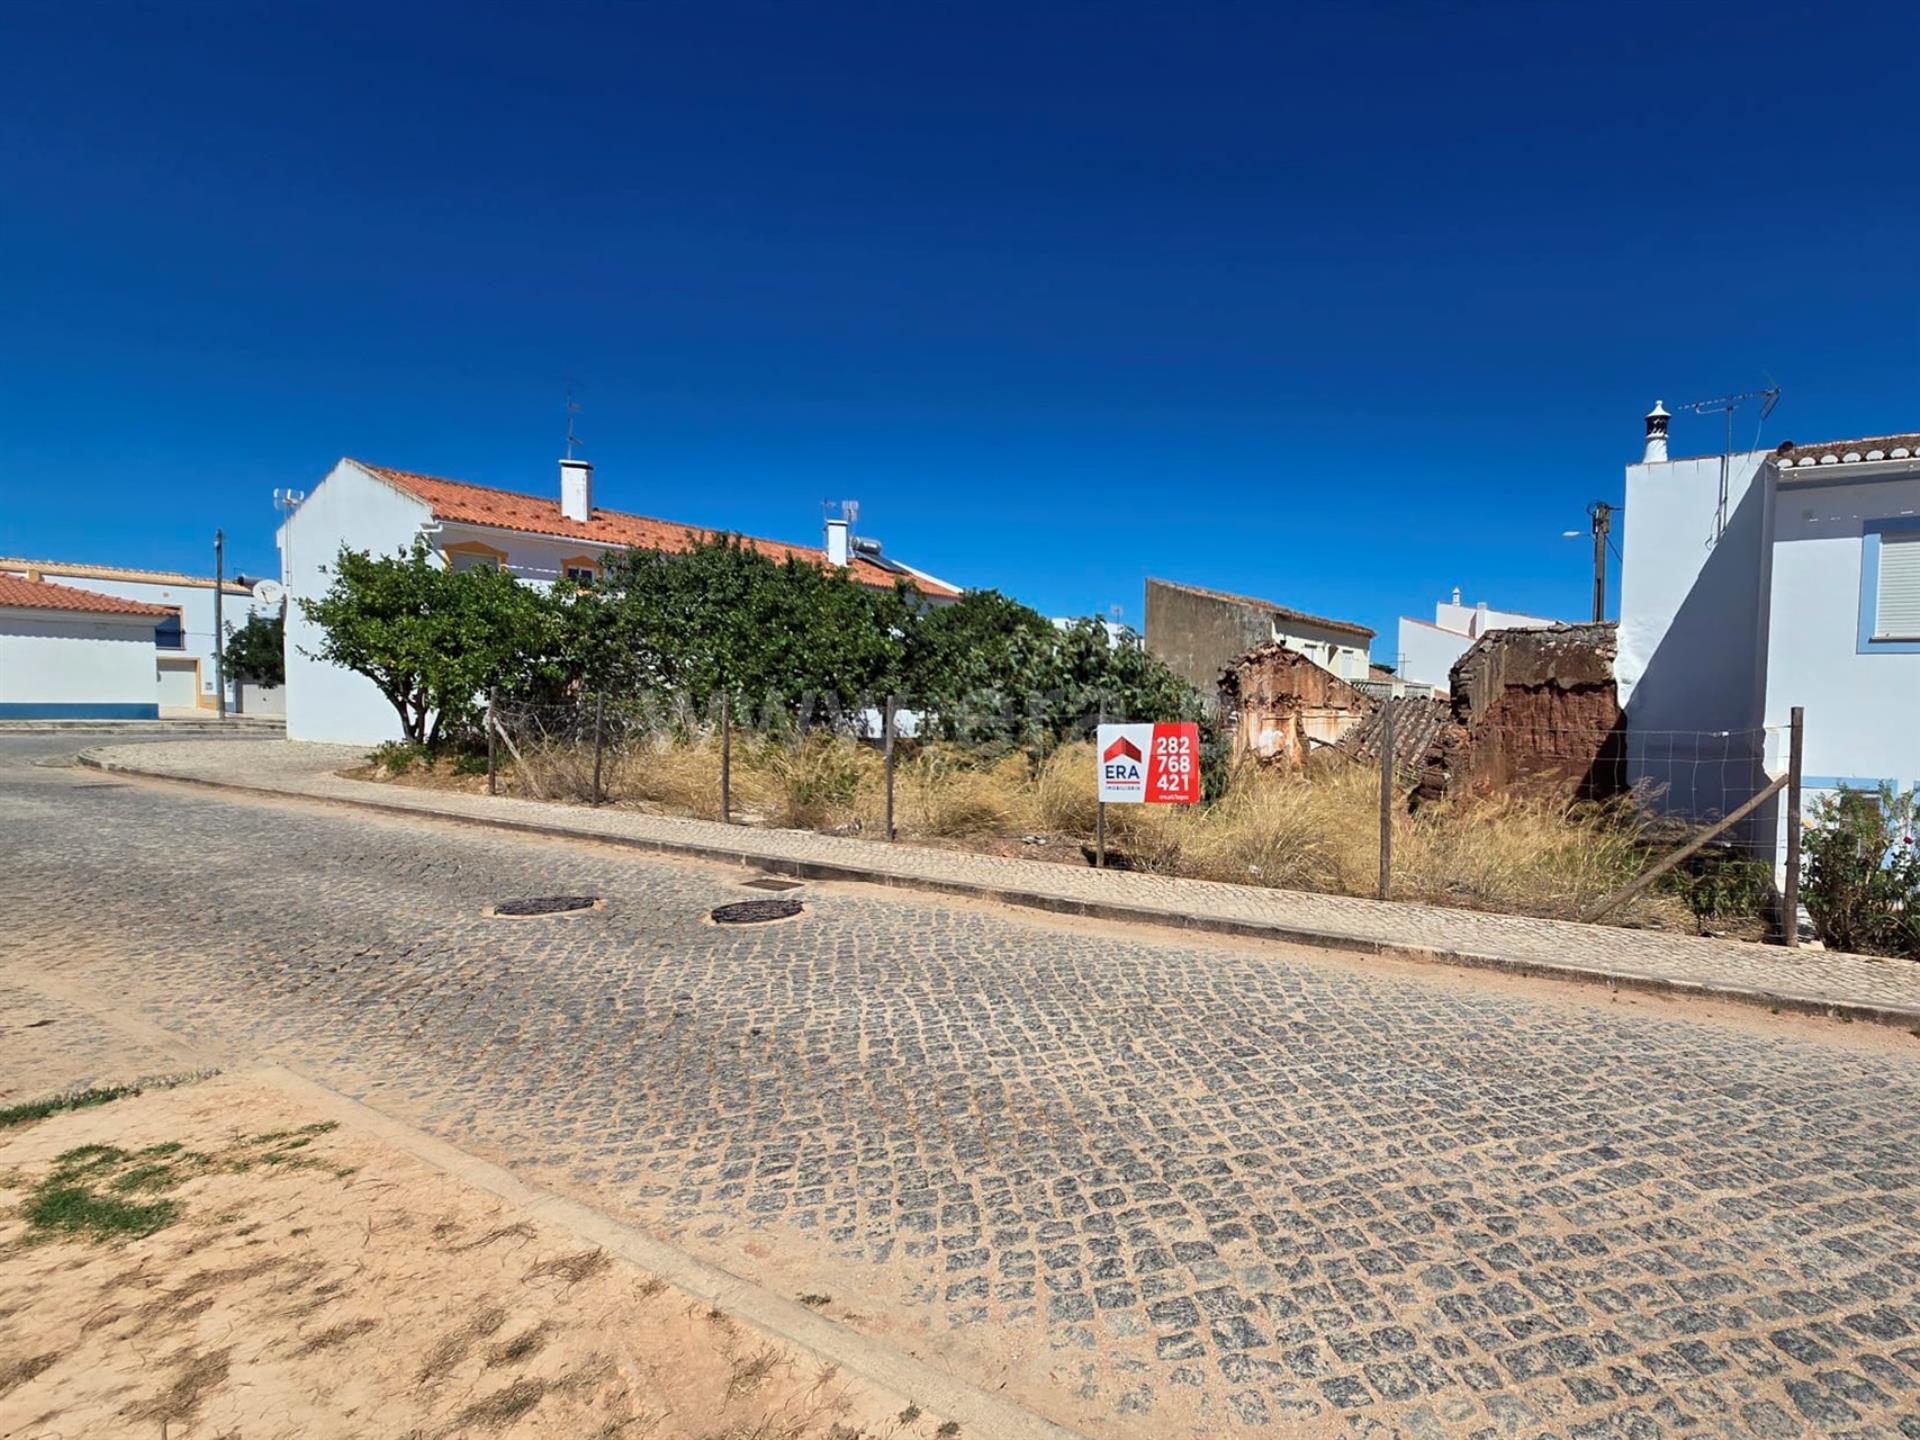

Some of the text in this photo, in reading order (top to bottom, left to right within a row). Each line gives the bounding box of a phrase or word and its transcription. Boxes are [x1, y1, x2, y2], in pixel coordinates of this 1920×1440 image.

[1156, 736, 1190, 754] 282
[1105, 765, 1140, 779] ERA
[1156, 755, 1190, 773] 768
[1156, 774, 1189, 791] 421
